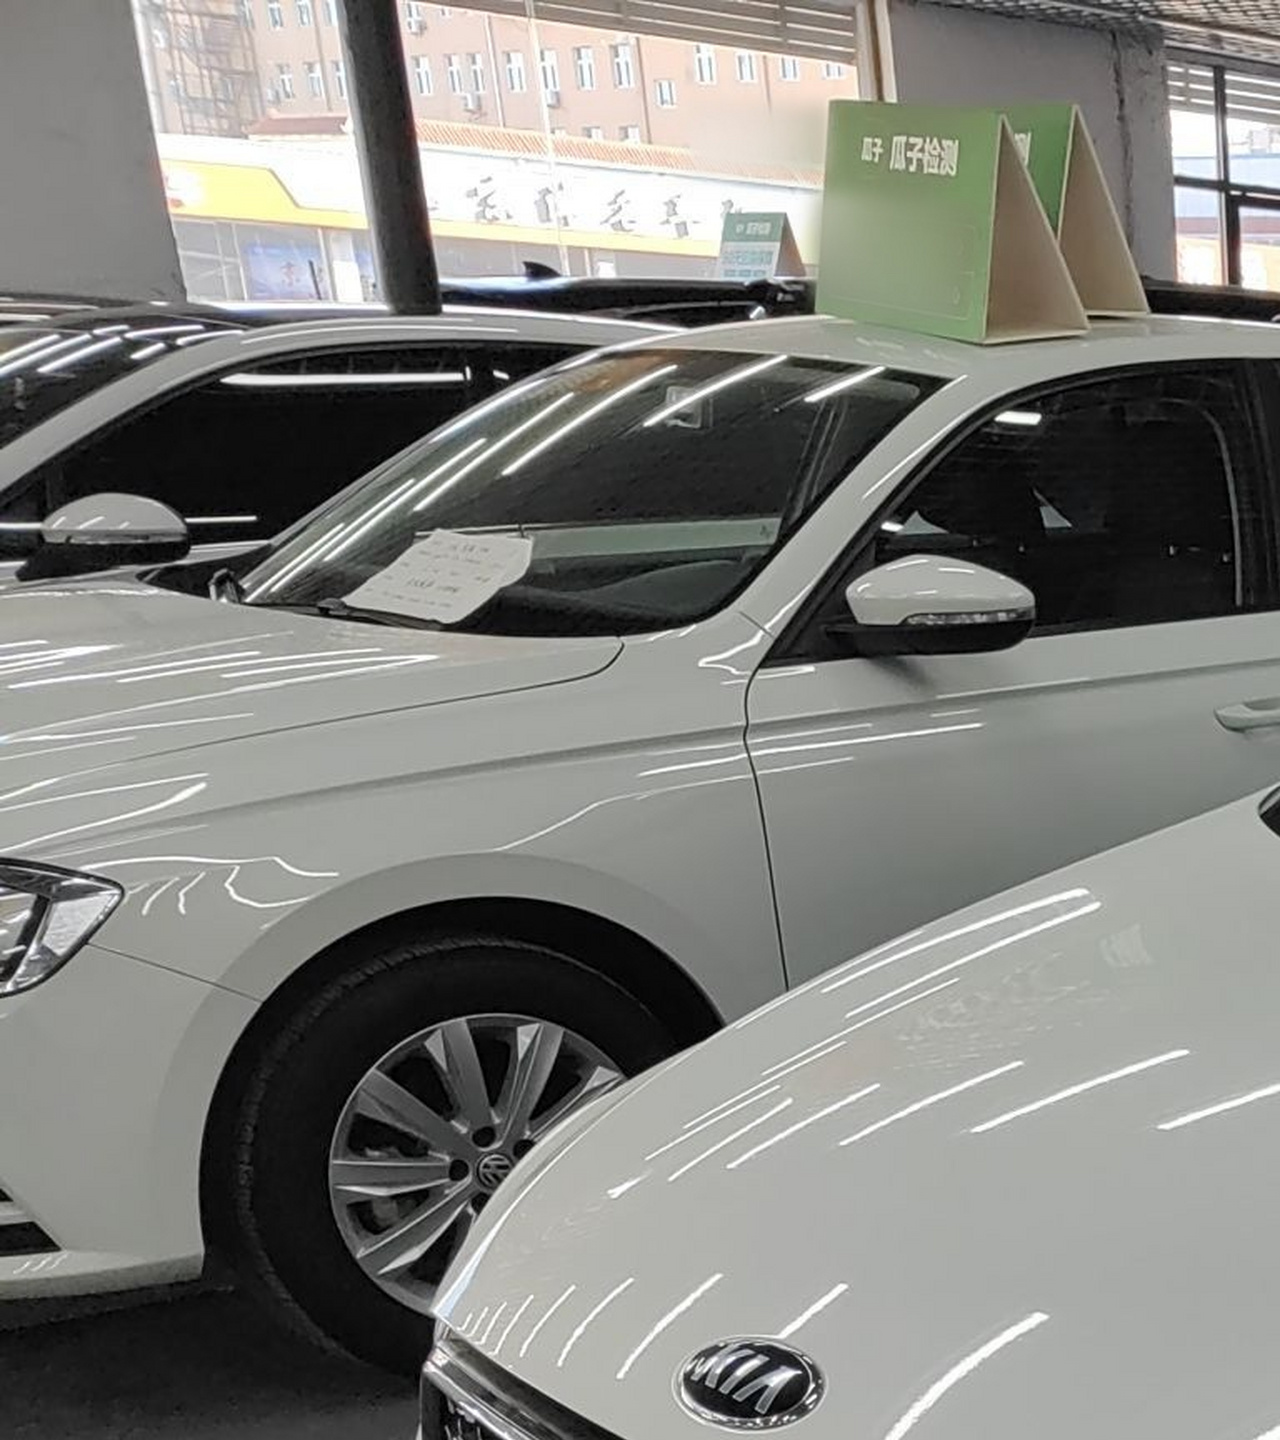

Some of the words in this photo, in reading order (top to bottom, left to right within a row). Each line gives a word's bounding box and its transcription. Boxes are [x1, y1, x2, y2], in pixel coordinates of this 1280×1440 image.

[861, 137, 884, 163] 瓜子
[889, 135, 960, 177] 瓜子检测
[690, 1342, 804, 1415] KIA
